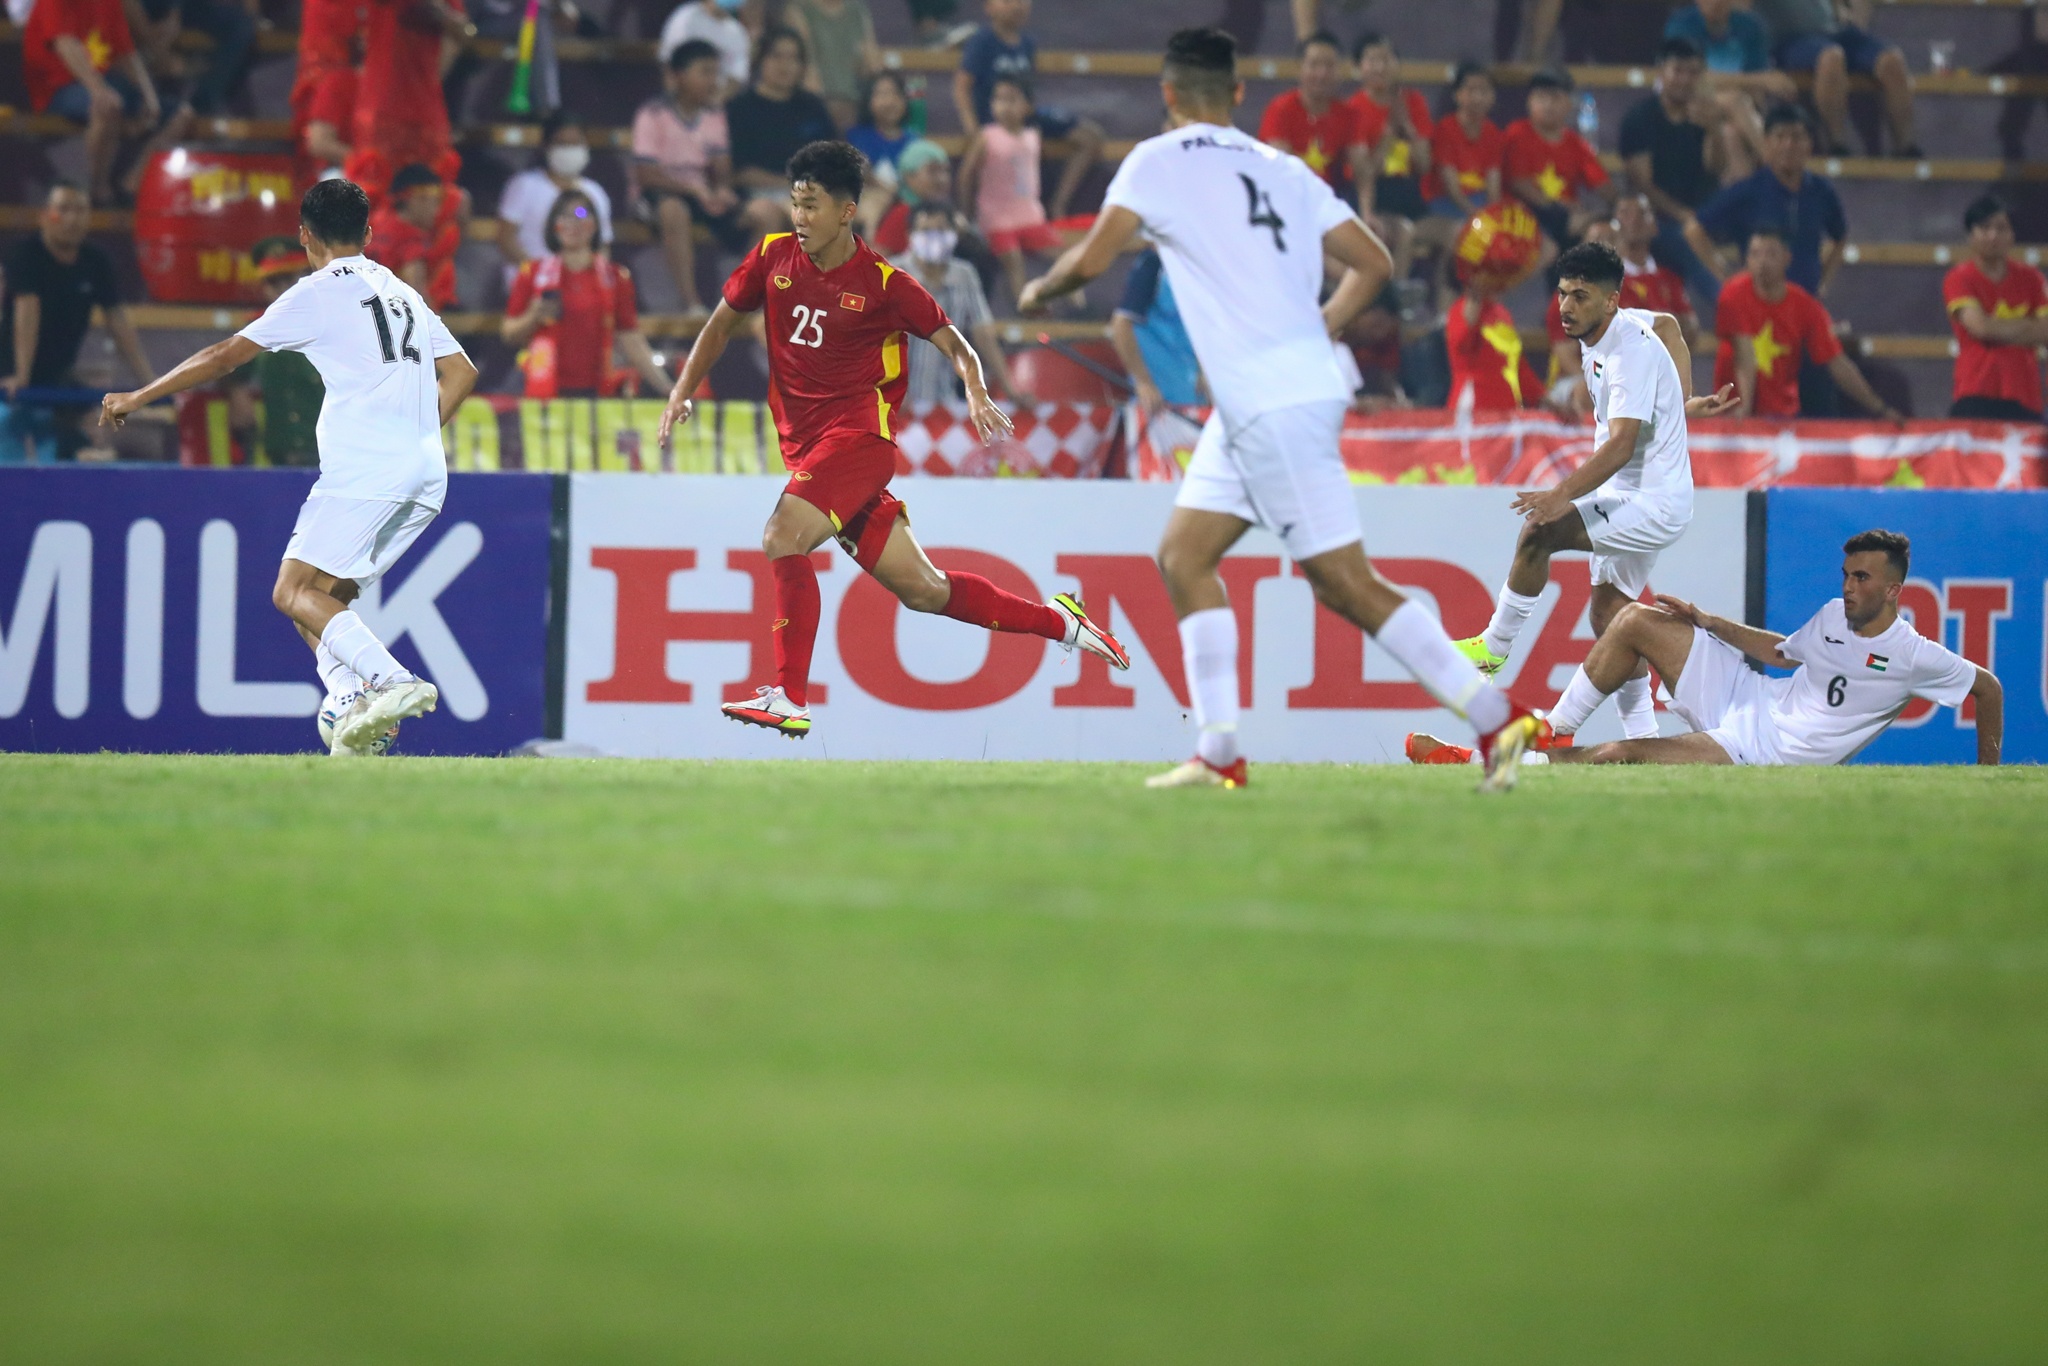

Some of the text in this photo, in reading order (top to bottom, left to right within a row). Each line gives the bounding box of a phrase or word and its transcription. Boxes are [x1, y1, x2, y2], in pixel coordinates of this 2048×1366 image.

[1236, 171, 1288, 253] 4
[361, 293, 421, 364] 12
[789, 304, 828, 348] 25
[585, 545, 1668, 713] HONDA
[1827, 674, 1848, 708] 6
